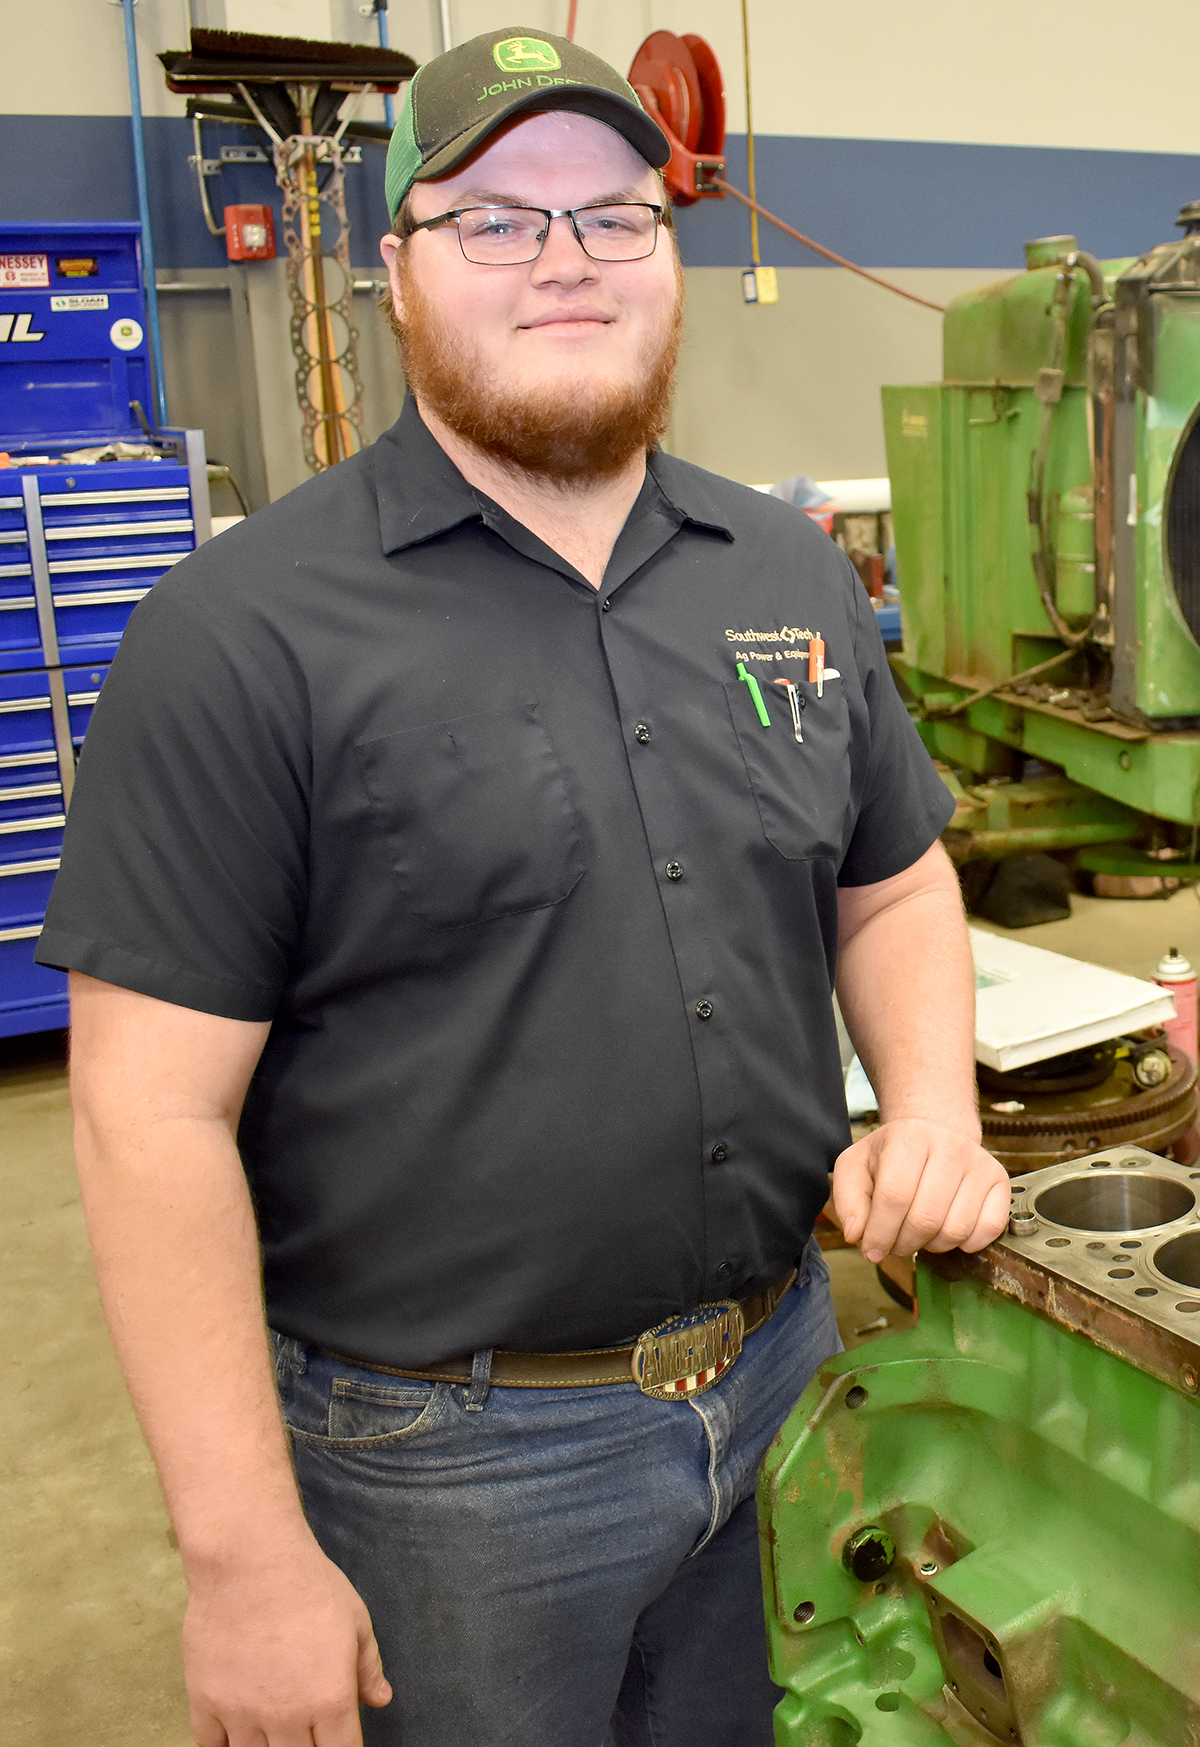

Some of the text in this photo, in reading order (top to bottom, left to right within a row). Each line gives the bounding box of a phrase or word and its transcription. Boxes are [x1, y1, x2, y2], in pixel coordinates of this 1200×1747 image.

[476, 77, 532, 101] JOHN
[724, 626, 814, 642] Southwest Tech
[735, 650, 749, 662] Ag
[749, 651, 773, 661] Power
[775, 651, 783, 661] &
